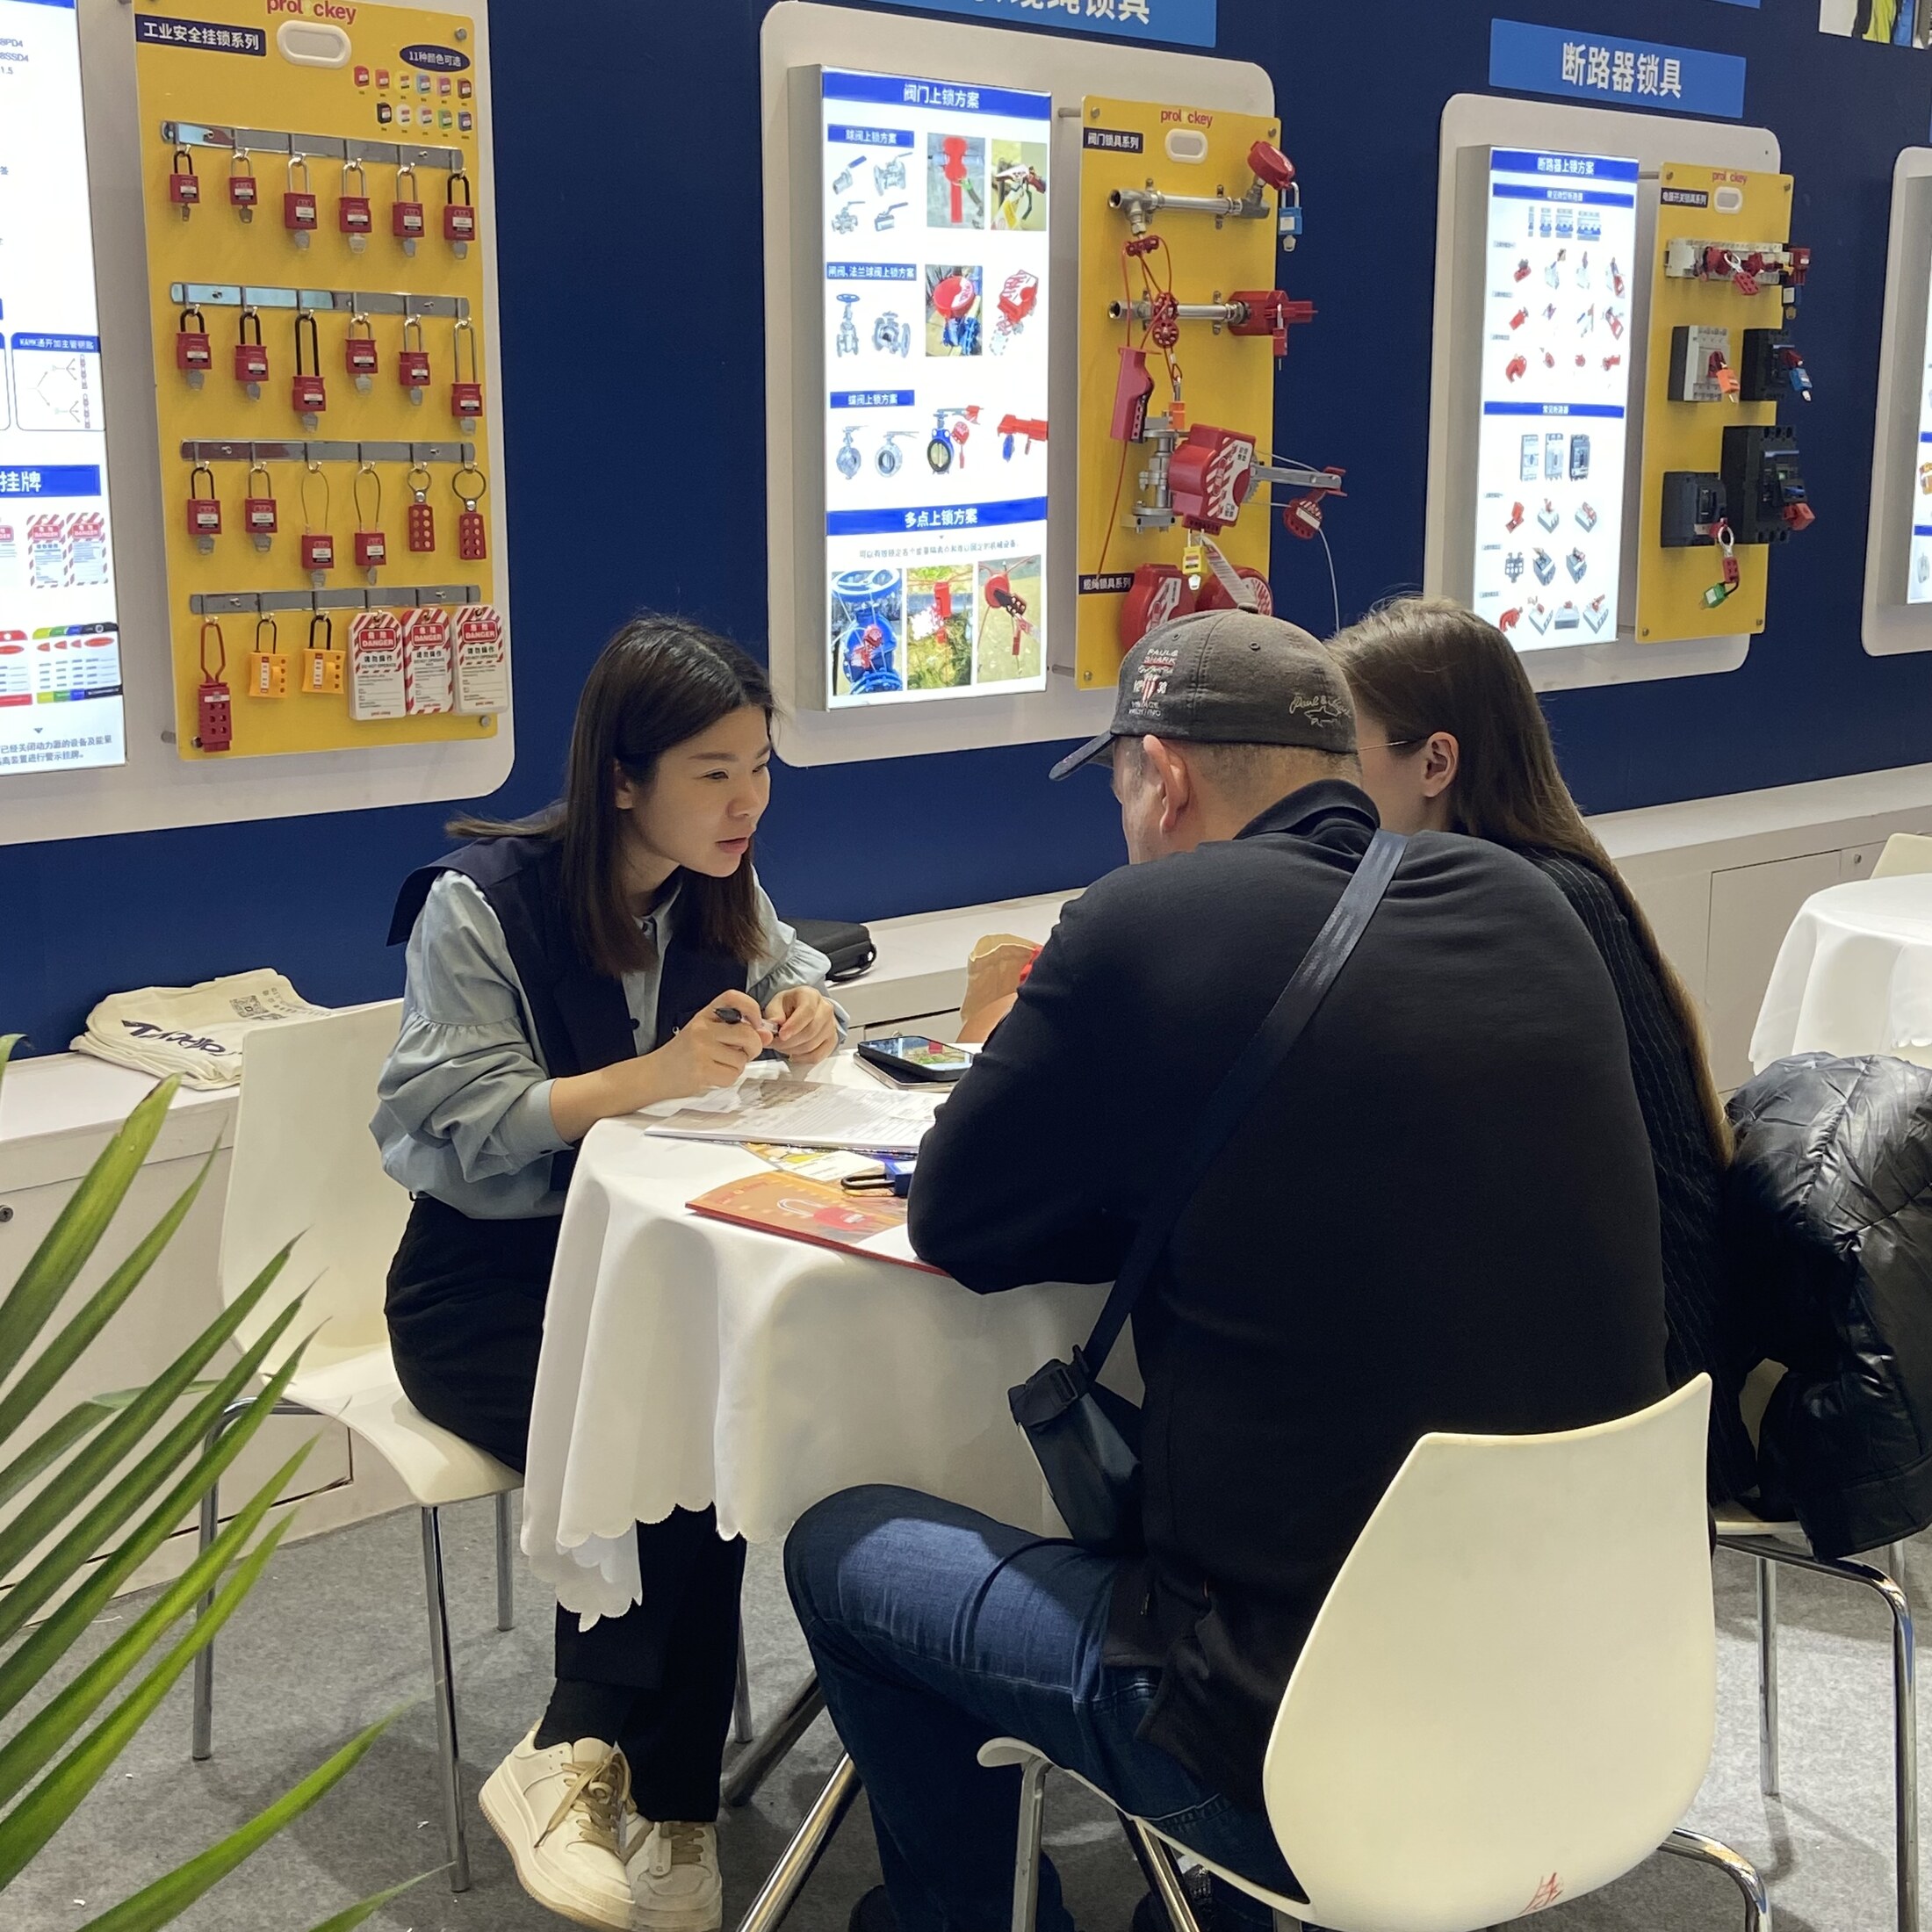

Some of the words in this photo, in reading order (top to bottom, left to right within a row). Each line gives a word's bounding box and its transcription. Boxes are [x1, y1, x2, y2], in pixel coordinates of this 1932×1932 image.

[143, 22, 260, 51] 工业安全挂锁系列
[1561, 42, 1682, 98] 断路器锁具
[904, 84, 980, 108] 阀门上锁方案
[845, 129, 898, 144] 球阀上锁方案
[1087, 133, 1140, 149] 阀门锁具系列
[1537, 156, 1595, 176] 断路器上锁方案
[847, 393, 898, 407] 蝶阀上锁方案
[0, 471, 42, 493] 挂牌
[904, 508, 978, 529] 多点上锁方案
[362, 638, 393, 647] DANGER
[414, 633, 442, 642] DANGER
[465, 631, 494, 639] DANGER
[0, 750, 83, 766] 离装置进行警示挂牌。
